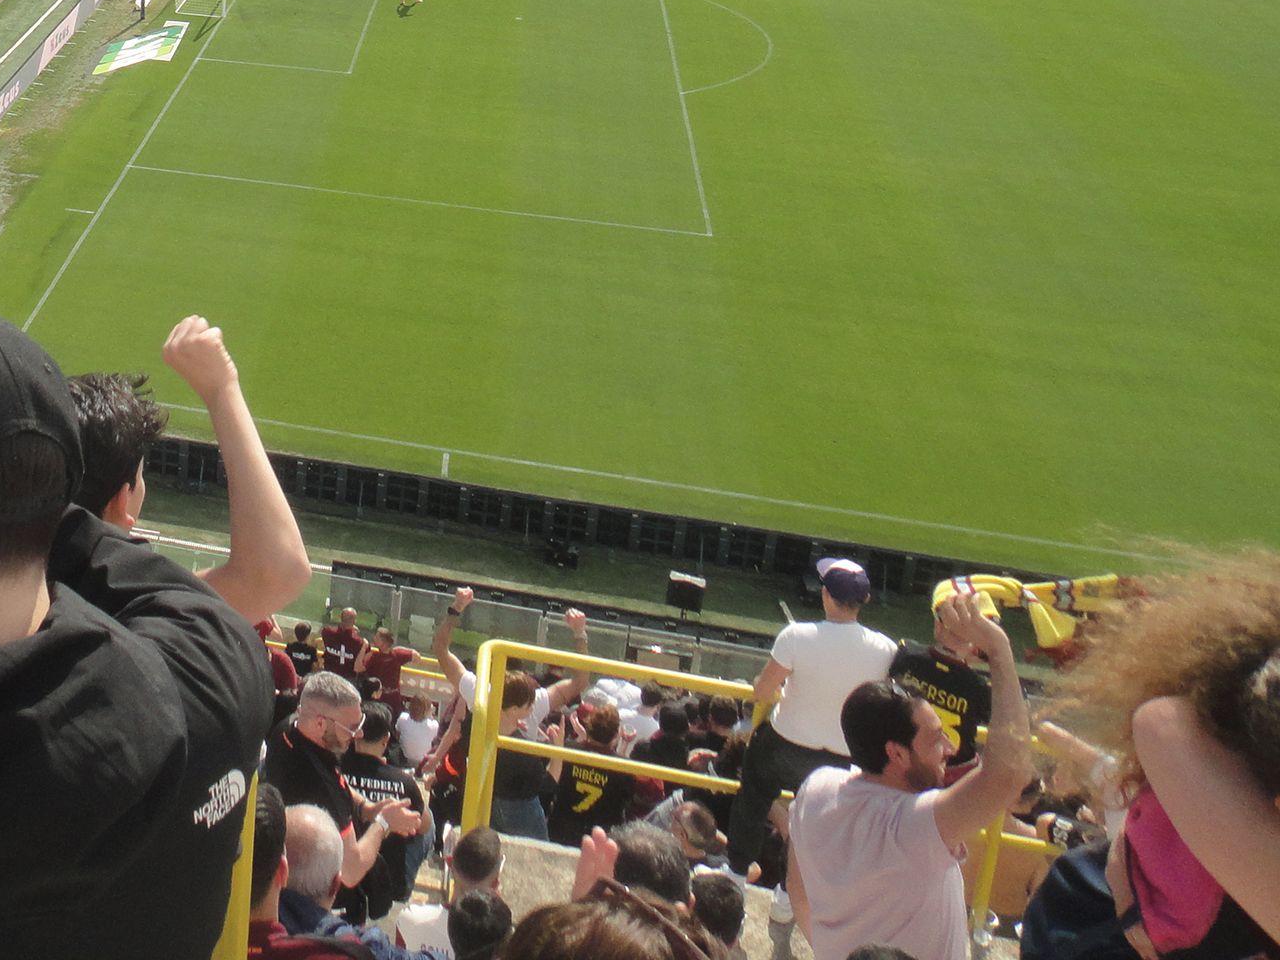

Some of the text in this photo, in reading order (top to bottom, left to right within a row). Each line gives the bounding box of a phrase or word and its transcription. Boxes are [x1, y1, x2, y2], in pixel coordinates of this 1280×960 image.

[209, 774, 228, 799] THE
[572, 765, 609, 787] RIBÉRY
[194, 787, 229, 825] NORTH
[572, 781, 603, 813] 7
[206, 800, 232, 829] FACE
